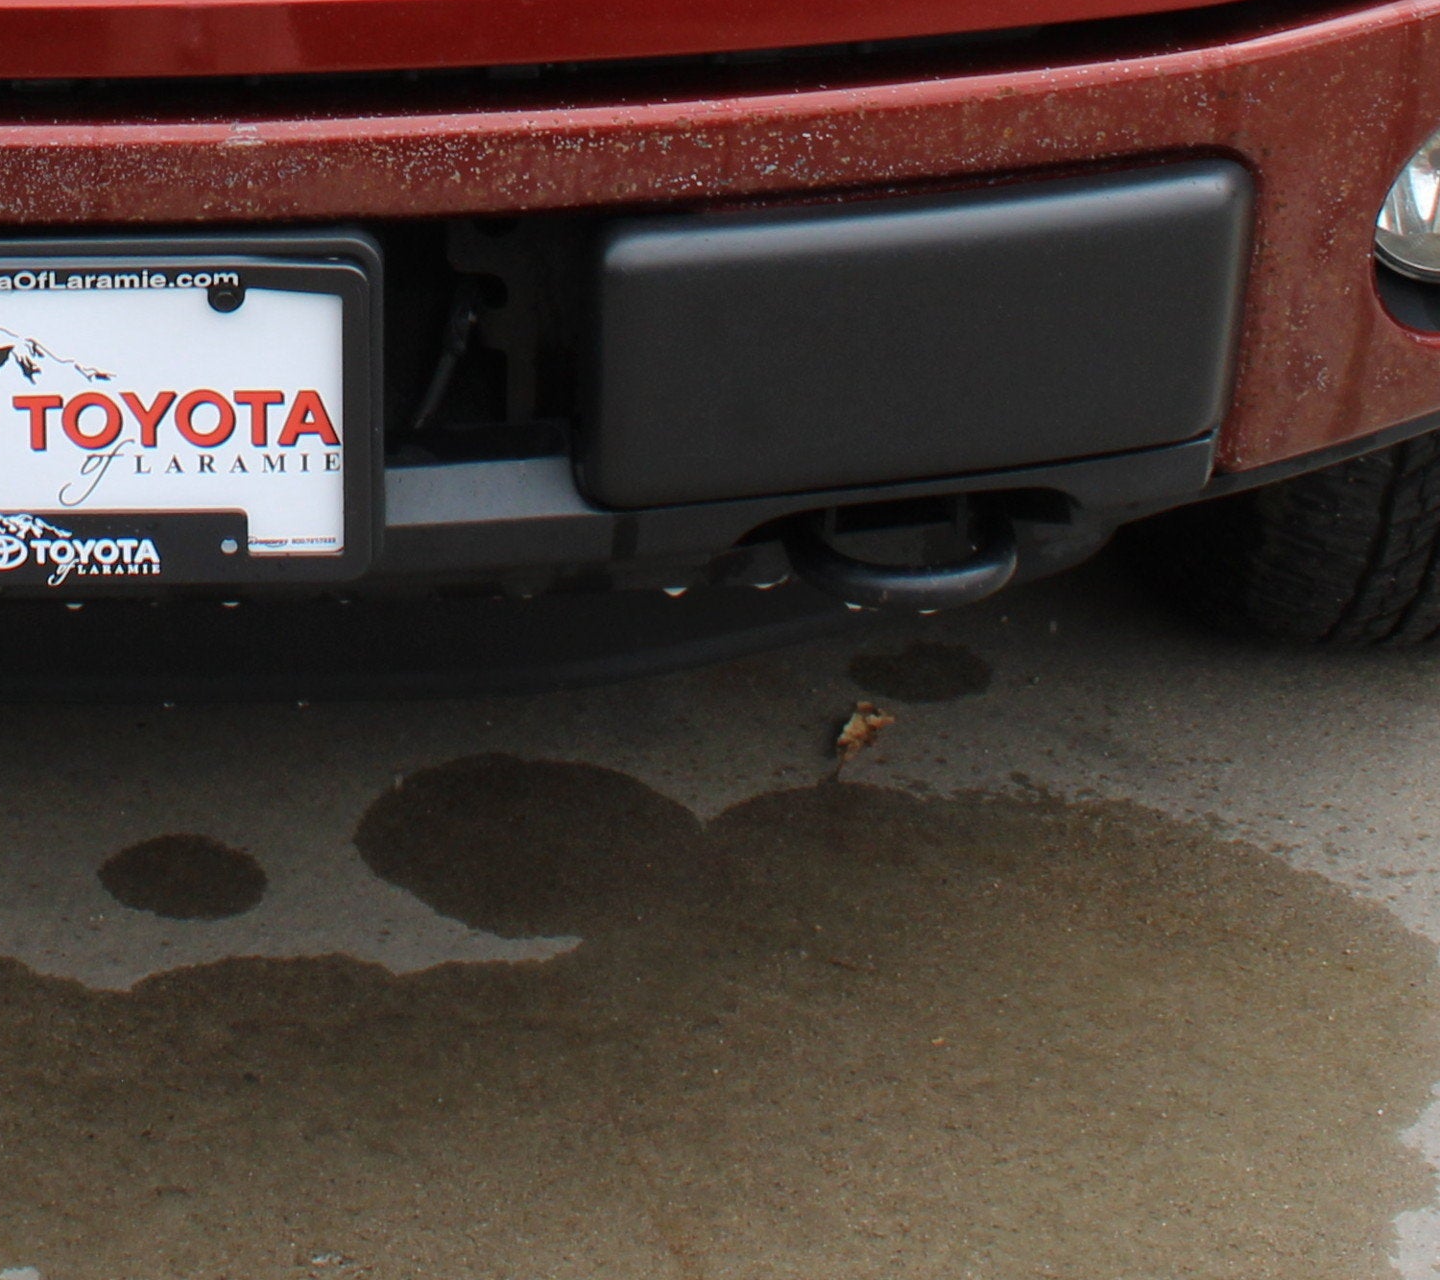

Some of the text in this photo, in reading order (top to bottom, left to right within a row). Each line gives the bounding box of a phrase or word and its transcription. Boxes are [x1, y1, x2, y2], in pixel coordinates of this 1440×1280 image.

[13, 389, 341, 452] TOYOTA
[58, 439, 342, 506] of LARAMIE
[29, 539, 161, 565] TOYOTA
[47, 559, 162, 587] of LARAMIE
